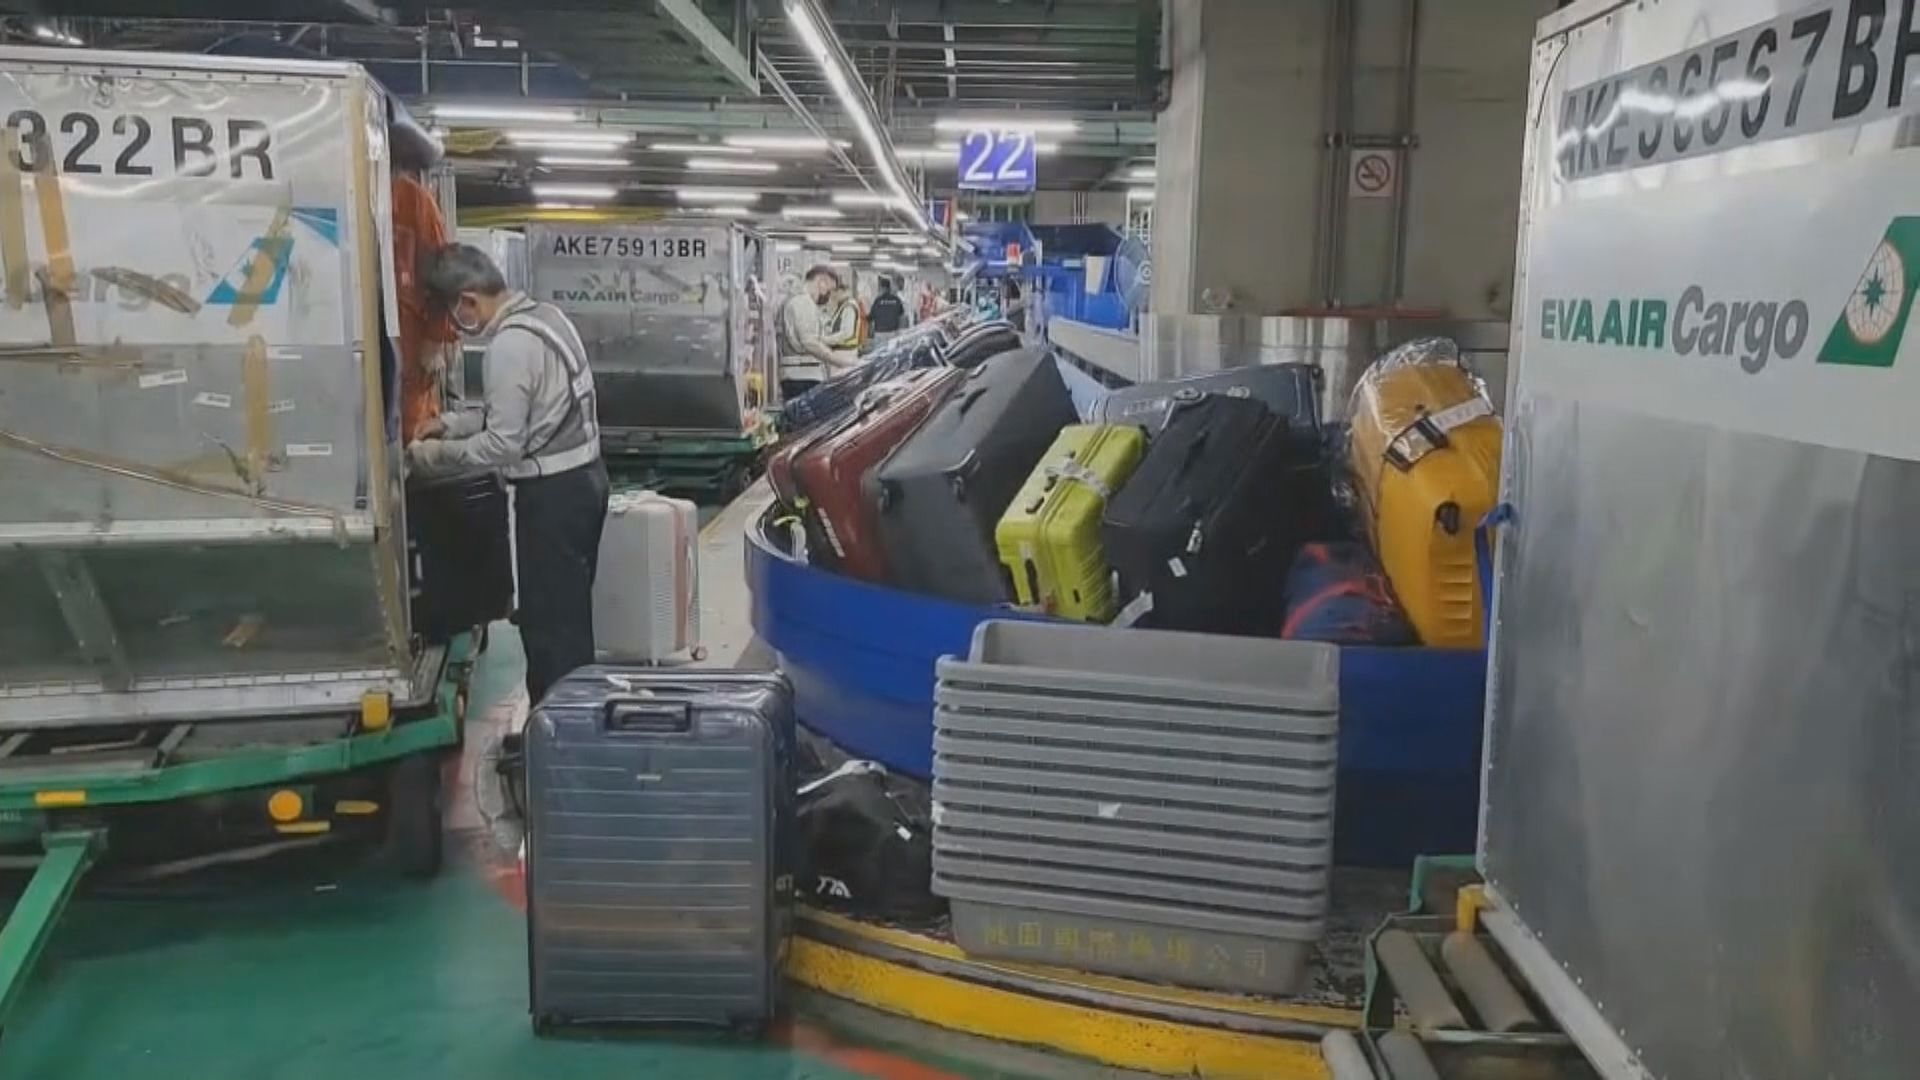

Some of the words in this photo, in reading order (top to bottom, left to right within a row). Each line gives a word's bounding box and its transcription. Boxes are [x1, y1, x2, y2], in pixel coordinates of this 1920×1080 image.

[964, 127, 1028, 181] 22
[553, 234, 706, 258] AKE75913BR
[628, 290, 680, 304] Cargo
[1672, 284, 1809, 375] Cargo
